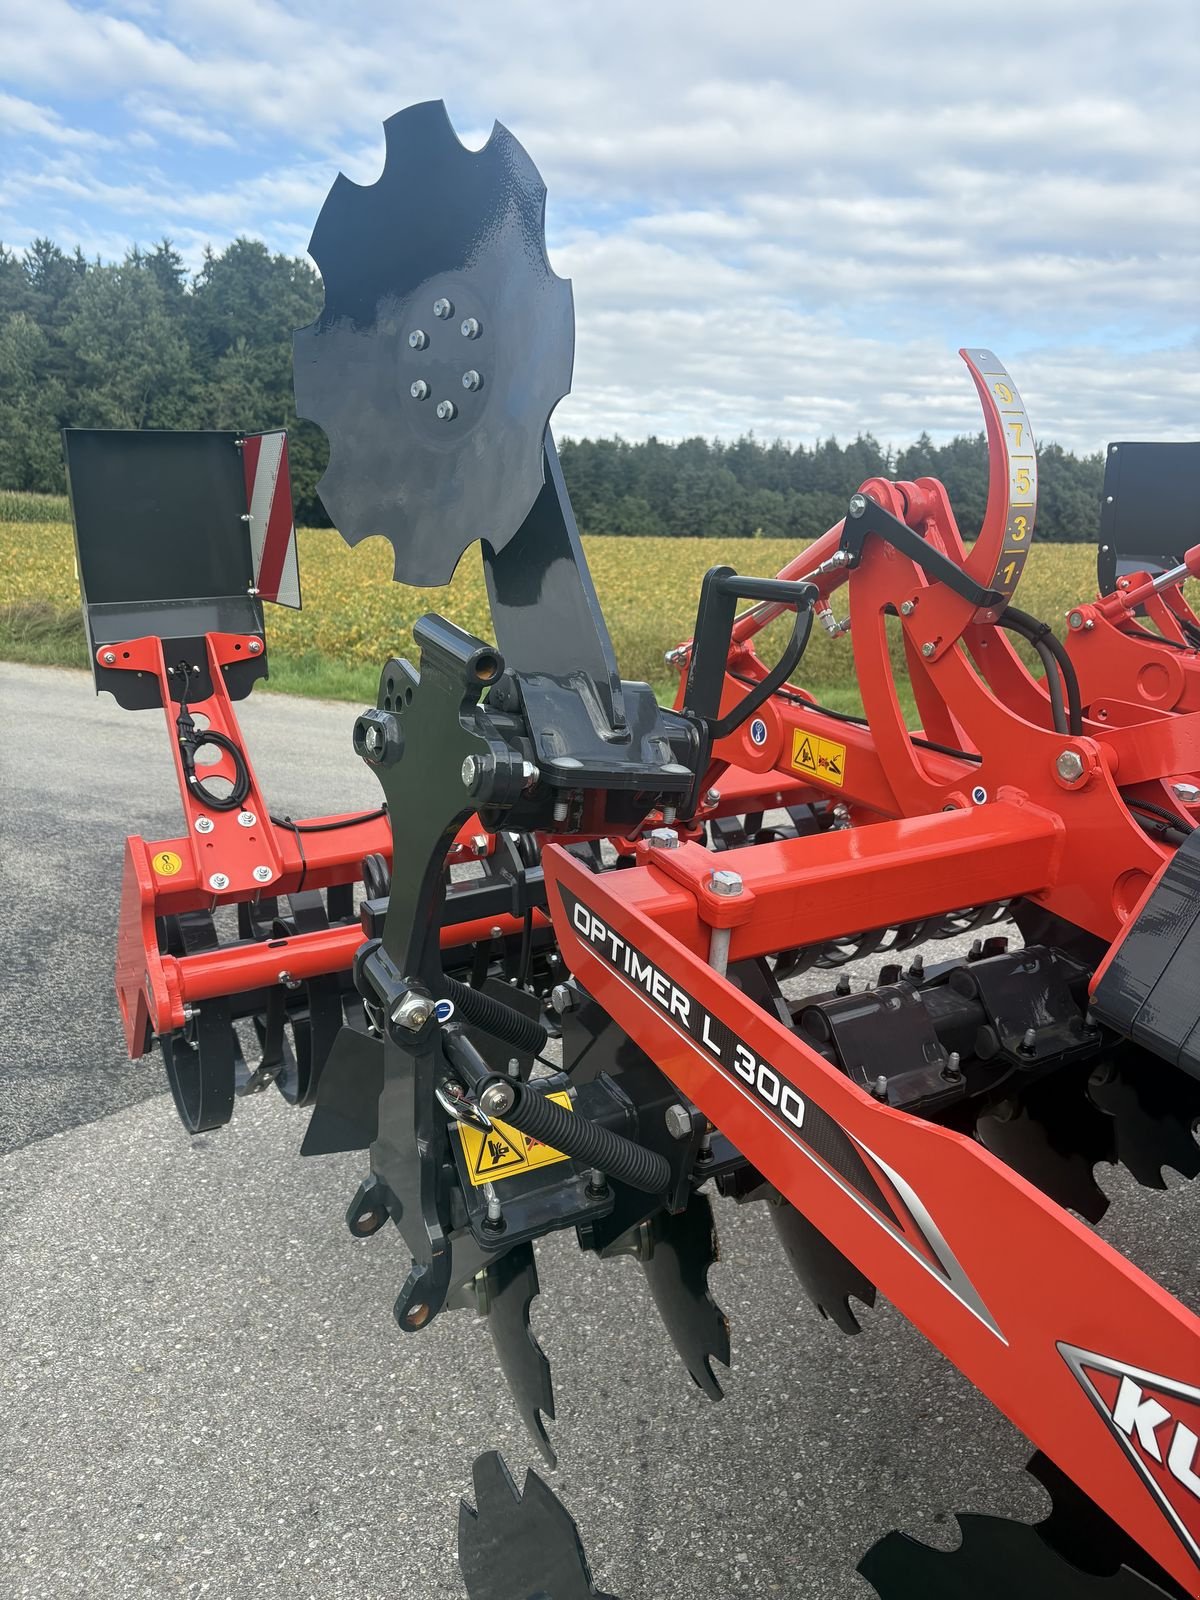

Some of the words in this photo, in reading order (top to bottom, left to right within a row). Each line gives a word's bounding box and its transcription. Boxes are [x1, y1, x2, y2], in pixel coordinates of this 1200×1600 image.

[994, 382, 1013, 403] 9
[1008, 423, 1023, 448] 7
[1016, 468, 1030, 495] 5
[1012, 515, 1026, 541] 3
[1003, 561, 1017, 584] 1
[573, 902, 691, 1029] OPTIMER
[702, 1014, 721, 1056] L
[734, 1043, 805, 1128] 300
